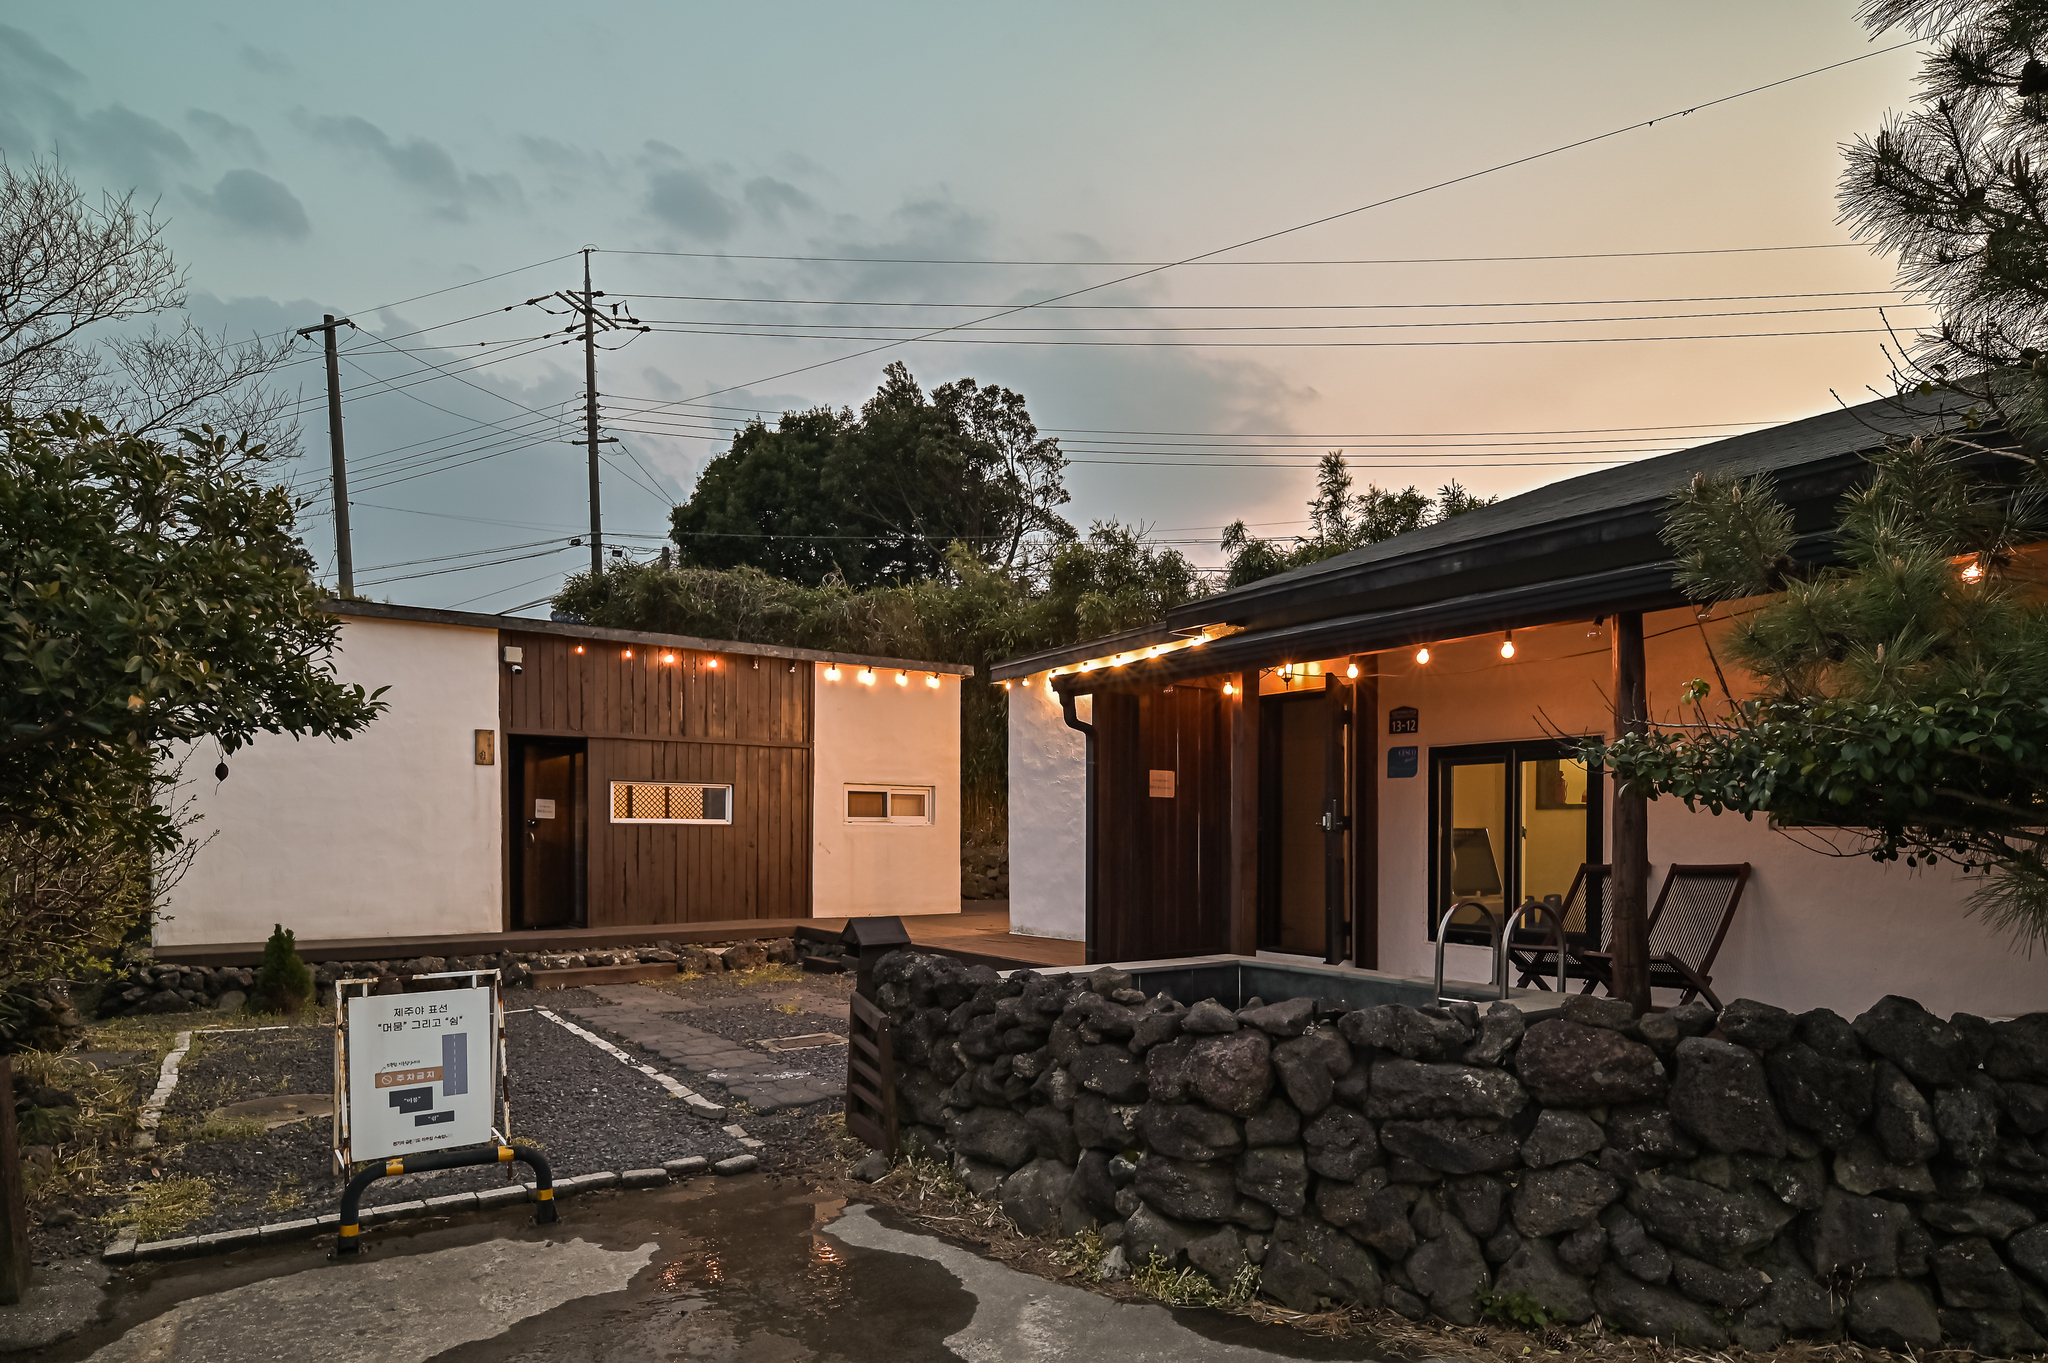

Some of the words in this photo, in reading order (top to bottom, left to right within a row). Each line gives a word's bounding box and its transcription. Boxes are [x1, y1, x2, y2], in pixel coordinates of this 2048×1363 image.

[1392, 720, 1416, 732] 13-12
[393, 1006, 425, 1017] 제주야
[428, 1004, 448, 1014] 표선
[411, 1018, 442, 1030] 그리고
[396, 1070, 435, 1082] 주차금지
